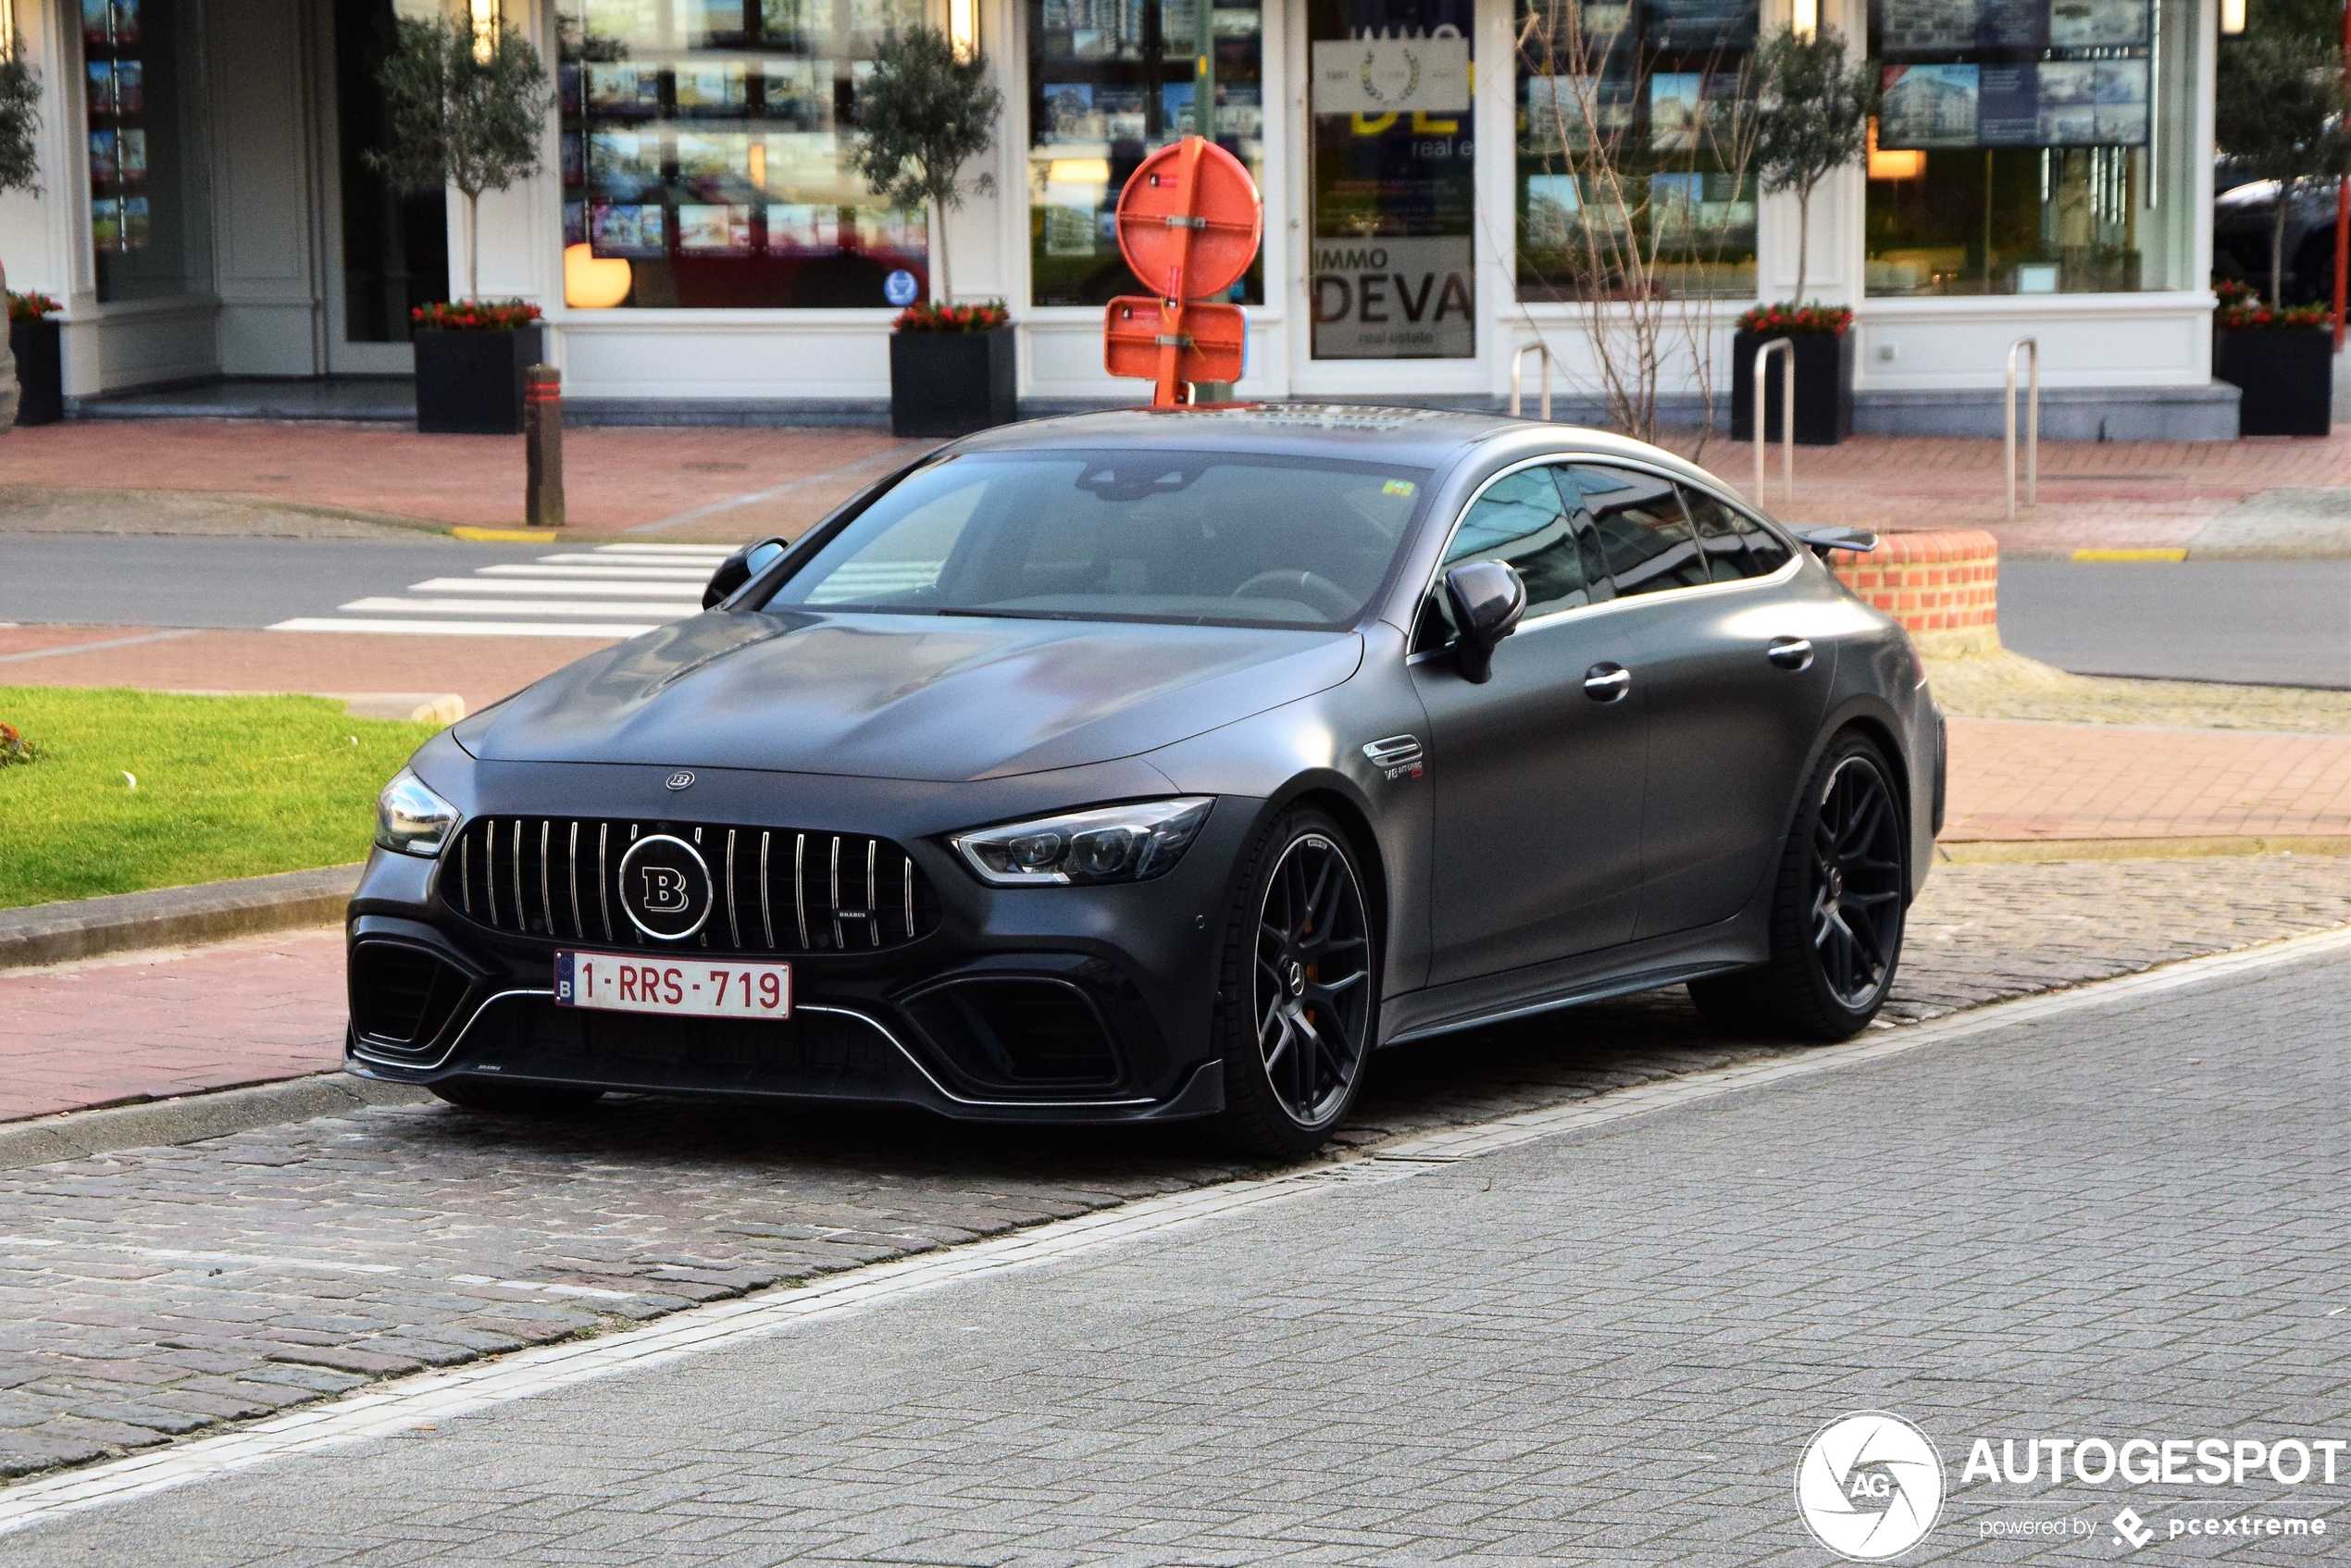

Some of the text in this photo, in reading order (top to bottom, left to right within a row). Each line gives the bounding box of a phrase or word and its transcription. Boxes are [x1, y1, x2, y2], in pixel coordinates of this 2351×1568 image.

[1412, 136, 1453, 157] real
[1315, 247, 1388, 269] IMMO
[1314, 272, 1474, 323] DEVA
[641, 865, 690, 913] B
[559, 980, 571, 999] B
[581, 962, 780, 1009] 1-RRS-719
